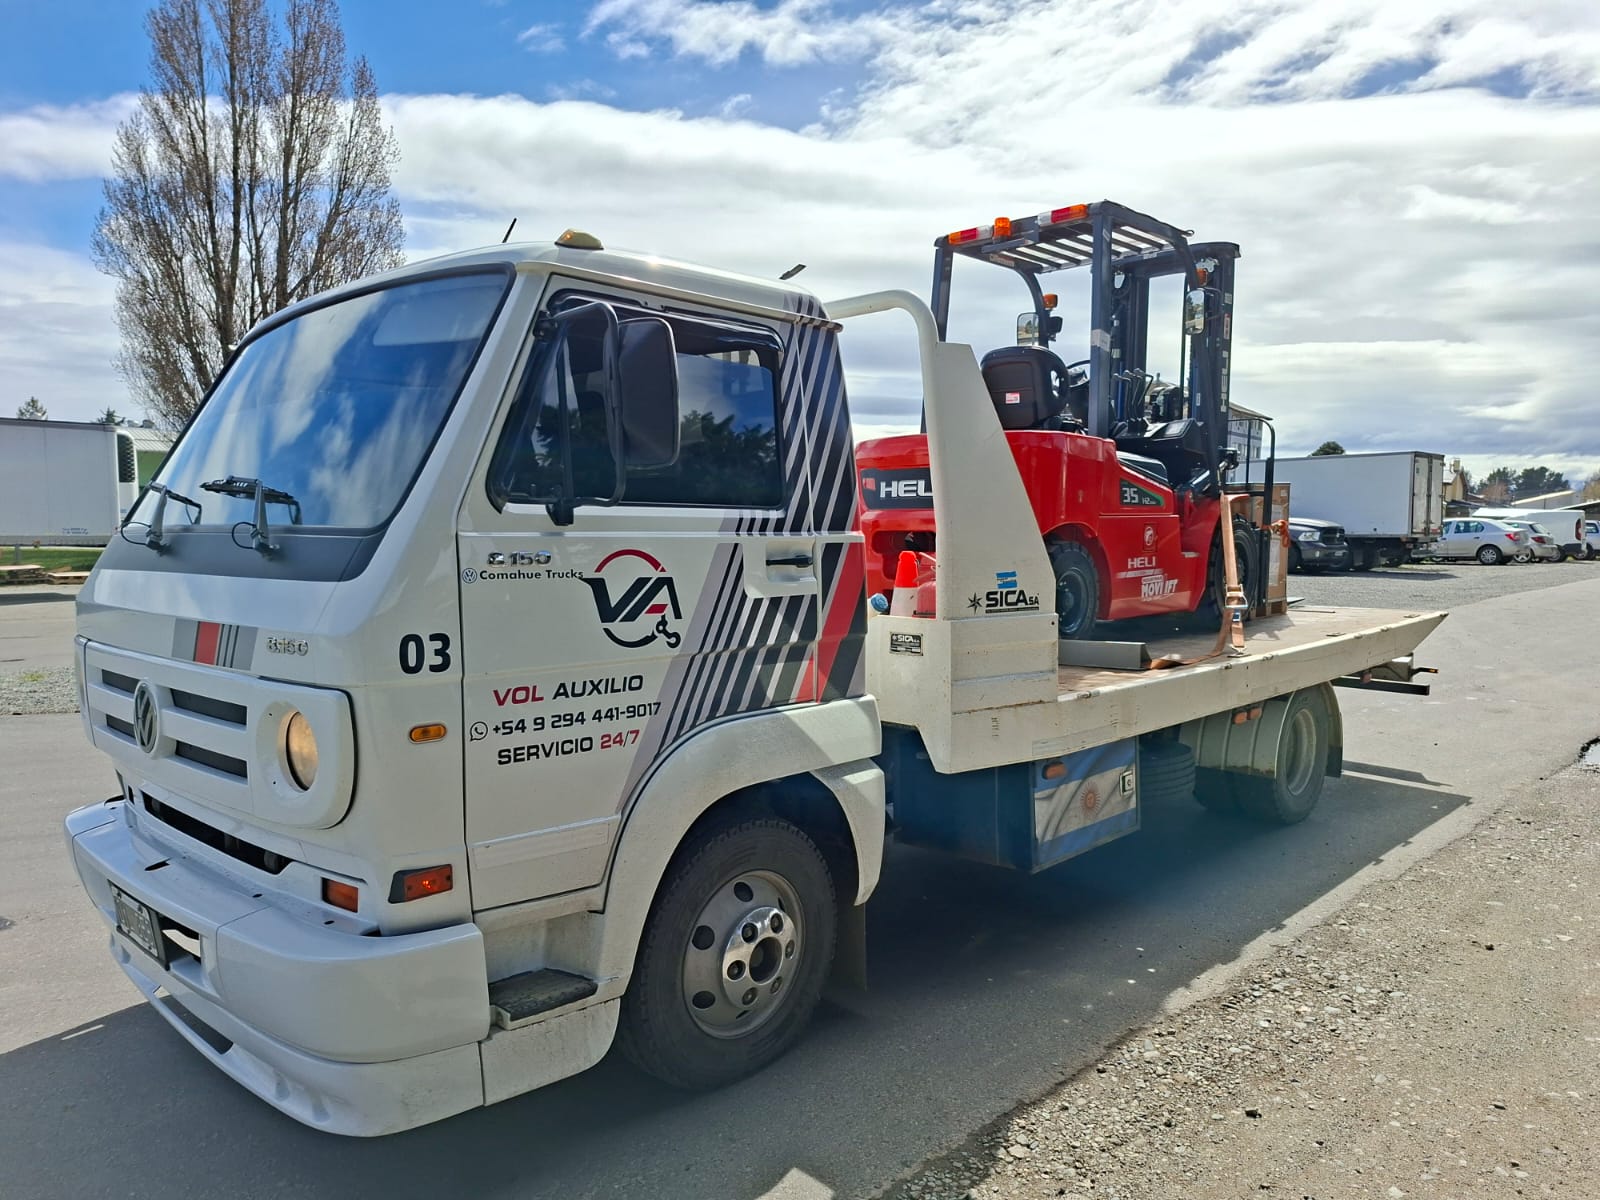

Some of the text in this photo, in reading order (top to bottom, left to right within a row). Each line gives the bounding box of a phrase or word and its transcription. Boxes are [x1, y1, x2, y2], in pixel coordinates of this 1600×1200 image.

[880, 480, 933, 498] HEL
[1122, 487, 1139, 503] 35
[1127, 556, 1156, 569] HELI
[480, 569, 584, 580] Comahue Trucks
[985, 589, 1029, 608] SICA
[399, 632, 451, 675] 03
[493, 674, 644, 707] VOL AUXILIO
[492, 702, 662, 736] +54 9 294 441-9017
[497, 729, 641, 765] SERVICIO 24/7
